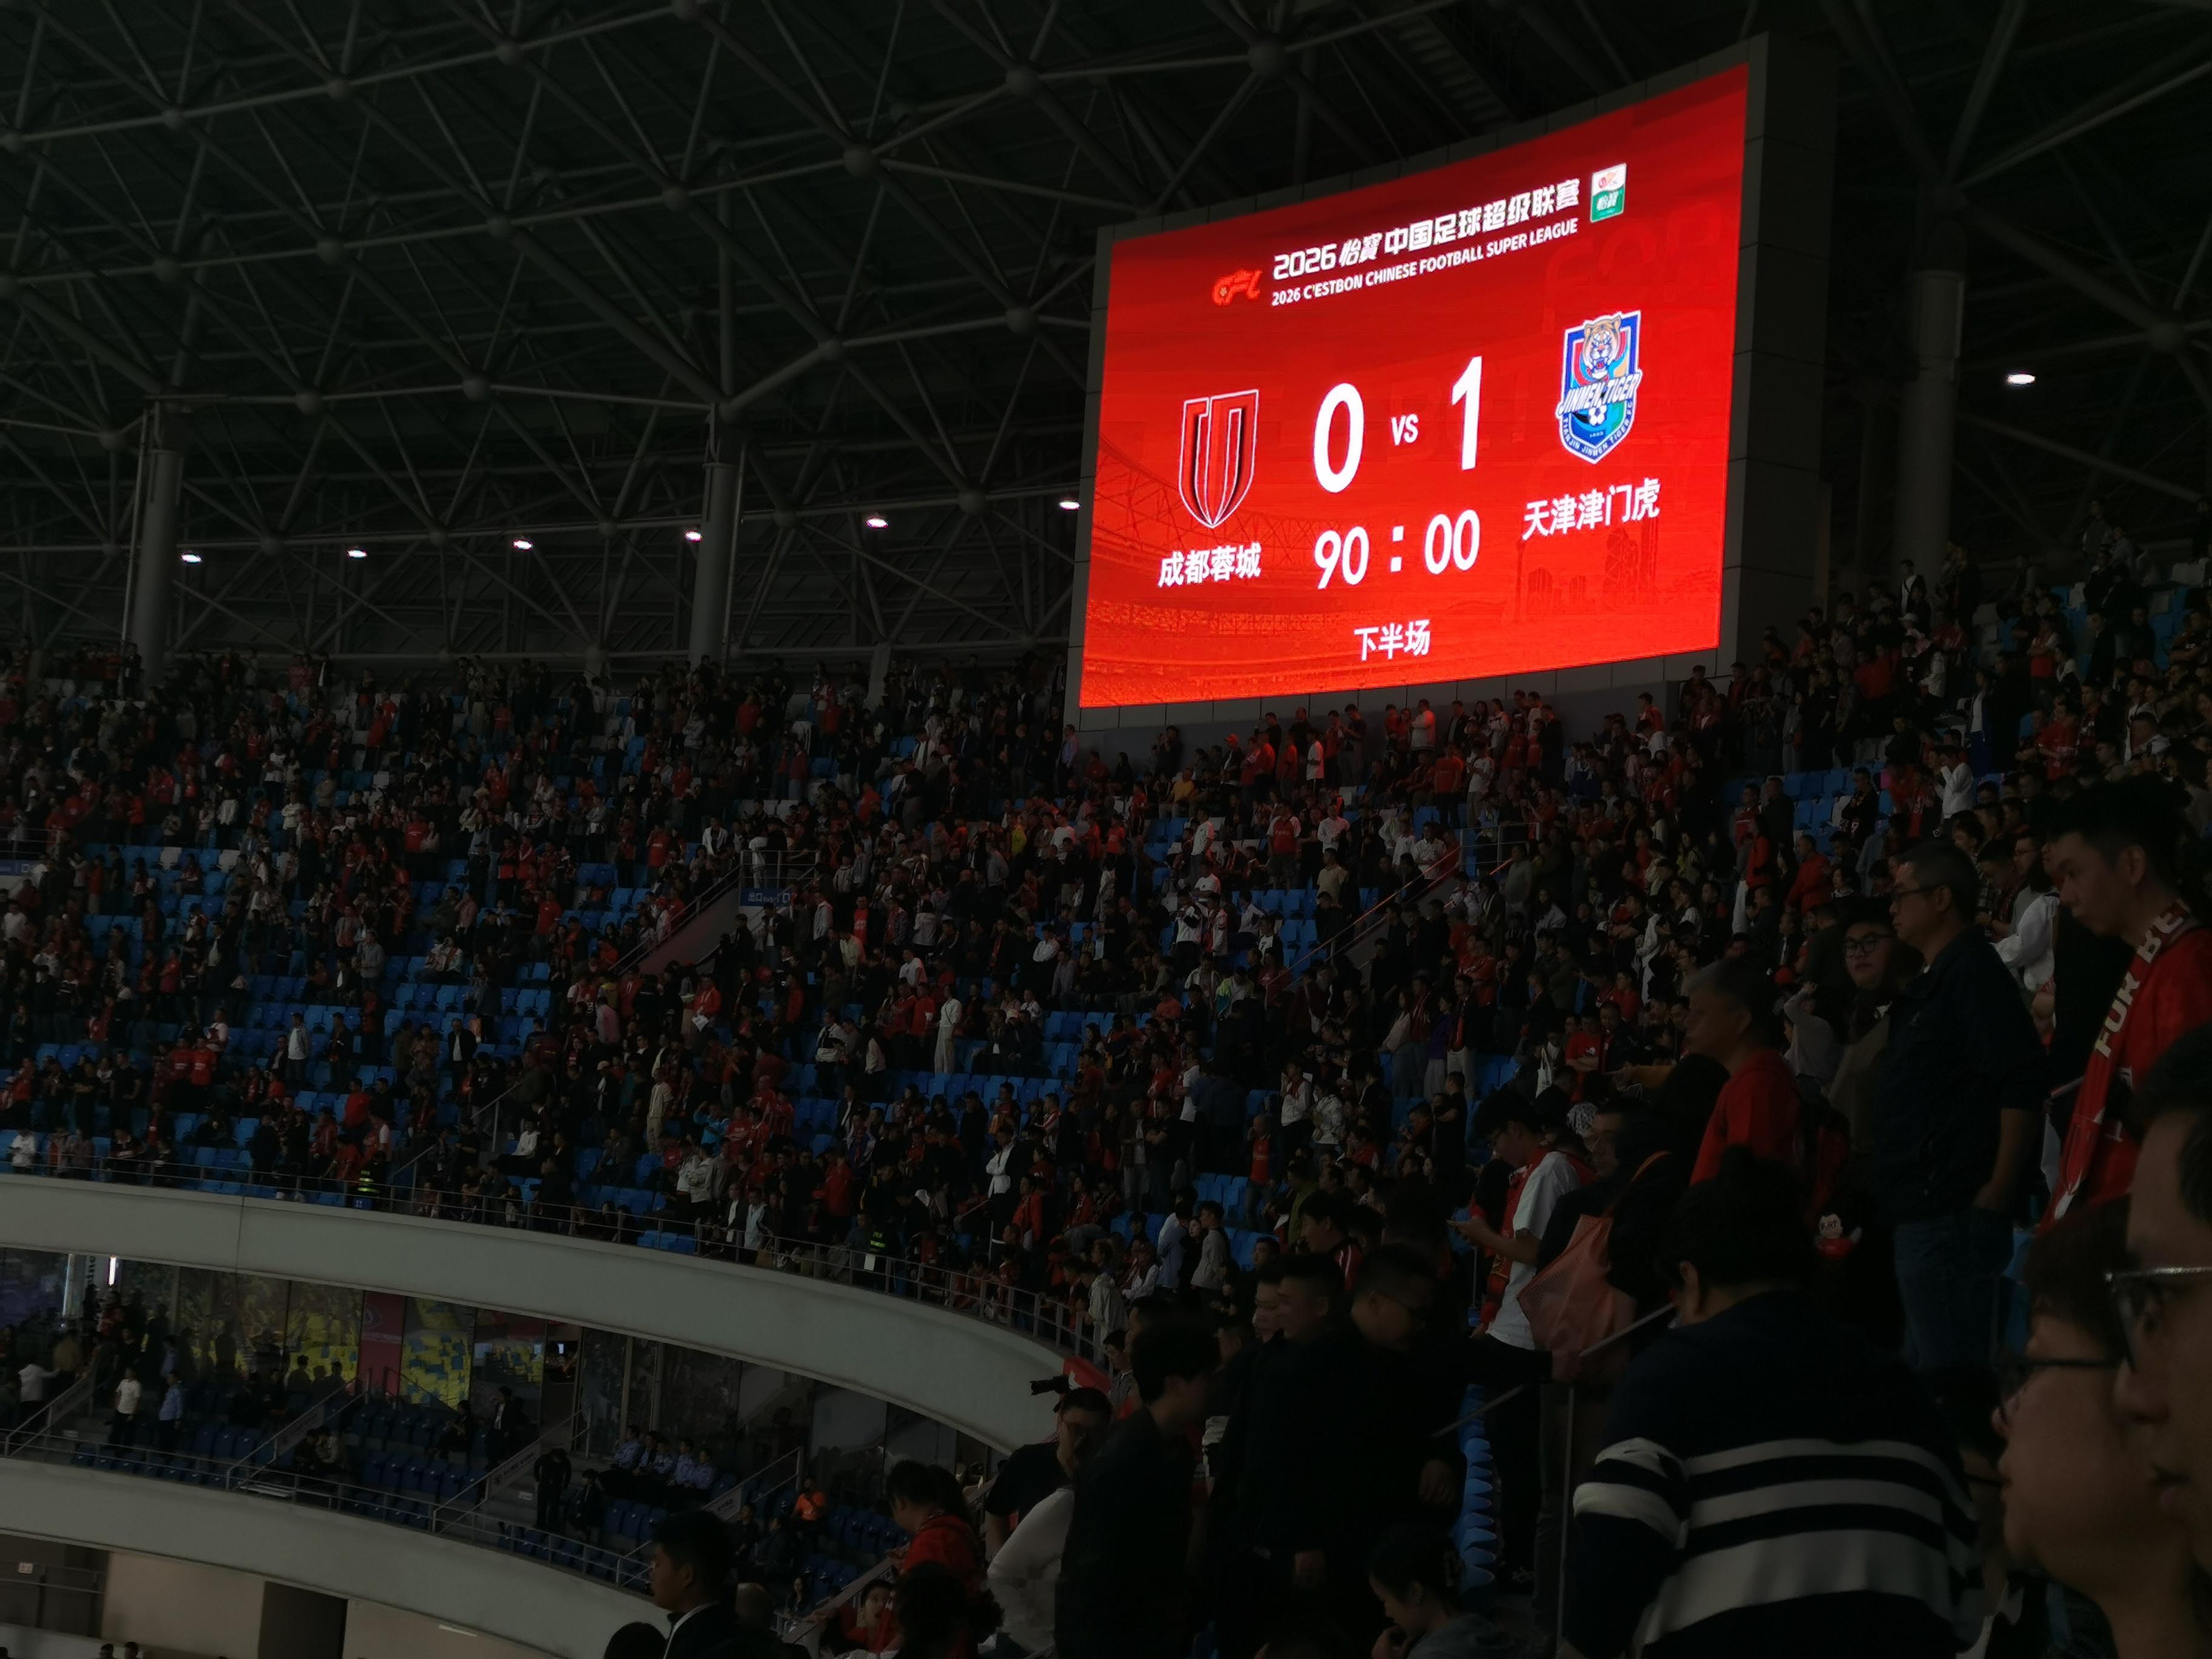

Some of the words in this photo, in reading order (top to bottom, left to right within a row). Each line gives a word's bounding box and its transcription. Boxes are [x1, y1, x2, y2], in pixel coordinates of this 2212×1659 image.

[1272, 287, 1301, 306] 2026
[1304, 274, 1363, 300] C'ESTBON
[1366, 261, 1418, 286] CHINESE
[1419, 245, 1484, 275] FOOTBALL
[1486, 233, 1528, 258] SUPER
[1529, 218, 1579, 246] LEAGUE
[1313, 383, 1364, 492] 0
[1392, 414, 1418, 446] VS
[1452, 355, 1483, 471] 1
[1521, 477, 1661, 541] 天津津门虎
[1158, 541, 1262, 588] 成都蓉城
[1353, 618, 1432, 661] 下半场
